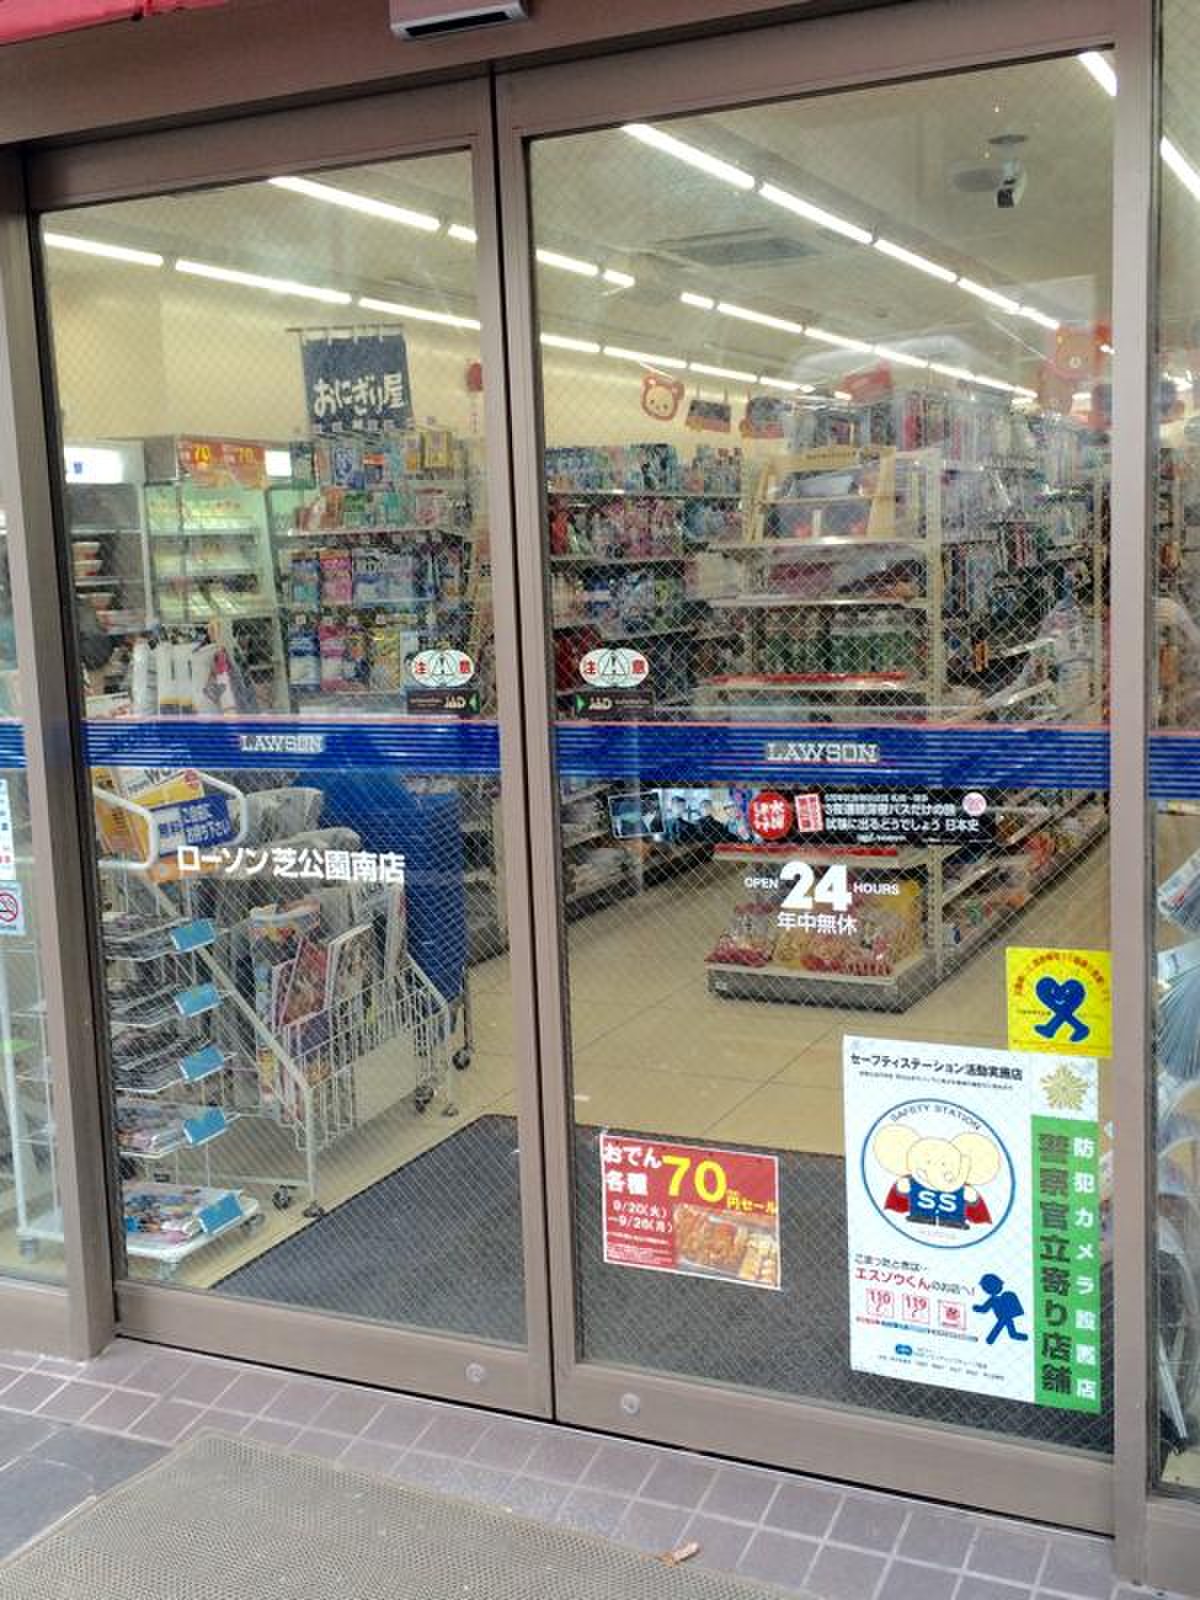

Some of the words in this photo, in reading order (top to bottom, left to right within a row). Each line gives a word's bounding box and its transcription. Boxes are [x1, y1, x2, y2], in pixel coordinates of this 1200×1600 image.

[312, 371, 405, 417] おにぎり屋
[240, 735, 323, 752] LAWSON
[766, 742, 878, 763] LAWSON
[744, 877, 779, 889] OPEN
[779, 861, 852, 911] 24
[853, 882, 901, 895] HOURS
[777, 911, 857, 935] 年中無休
[602, 1143, 662, 1169] おでん
[917, 1190, 957, 1212] SS
